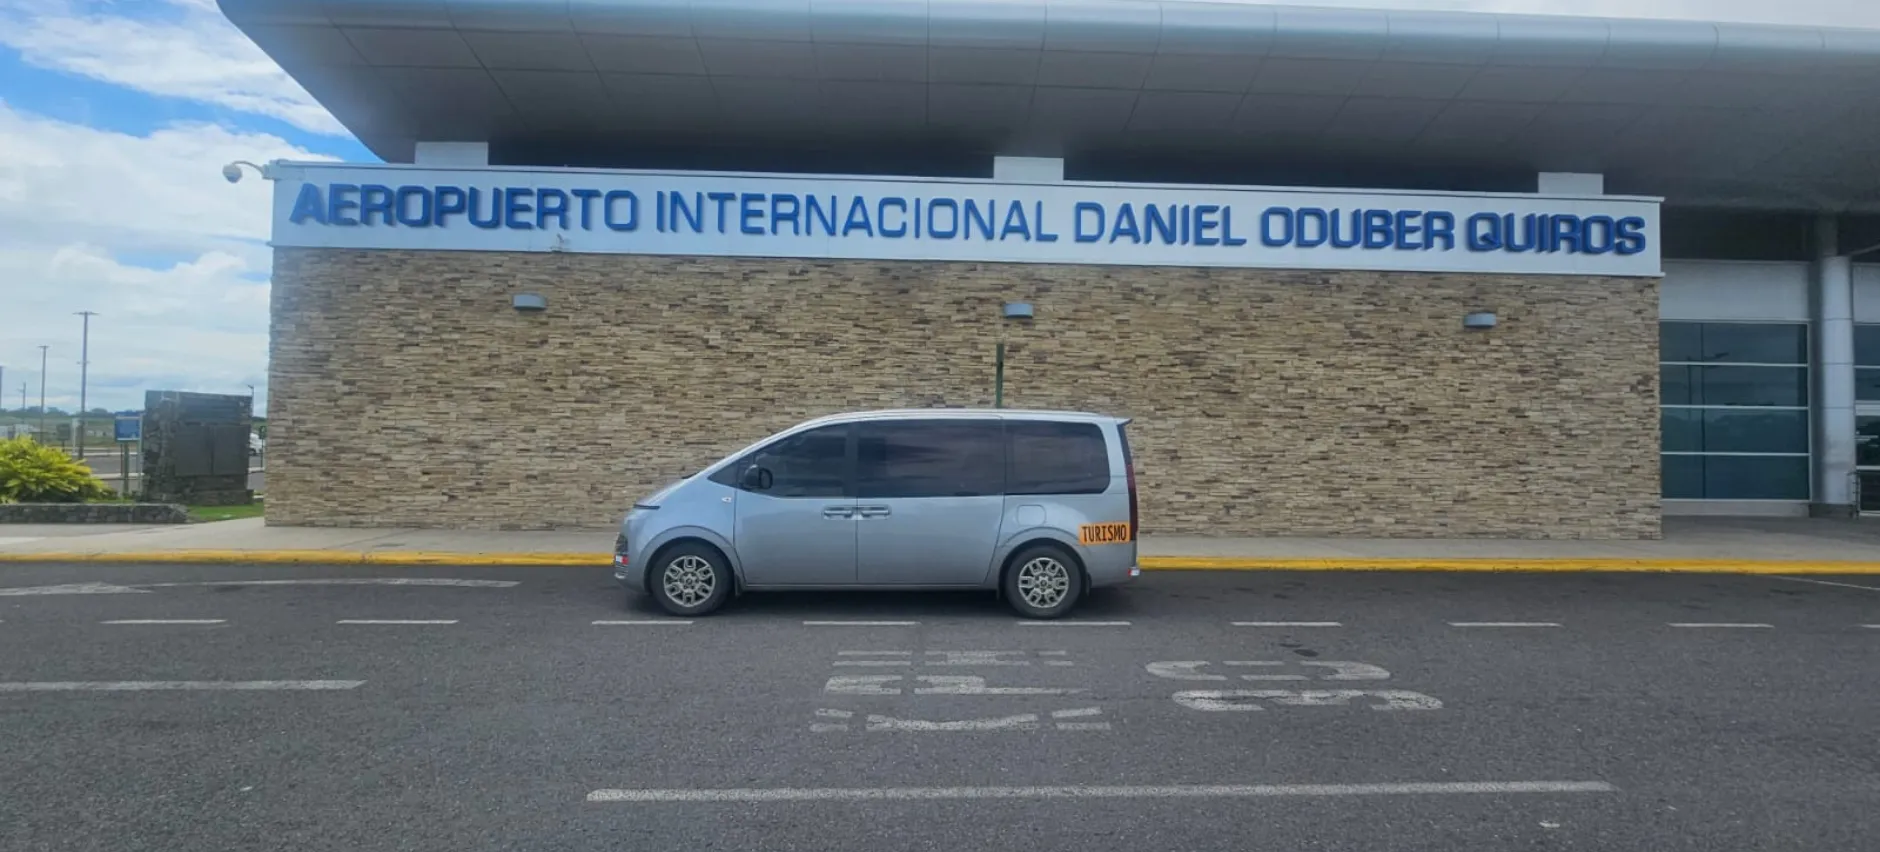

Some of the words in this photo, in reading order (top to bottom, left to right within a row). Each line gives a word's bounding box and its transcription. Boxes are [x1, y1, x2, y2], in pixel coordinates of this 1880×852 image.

[290, 183, 638, 231] AEROPUERTO
[656, 190, 1058, 242] INTERNACIONAL
[1074, 202, 1246, 246] DANIEL
[1260, 206, 1455, 251] ODUBER
[1467, 211, 1646, 255] QUIROS
[1081, 524, 1127, 542] TURISMO
[809, 650, 1111, 732] KPH
